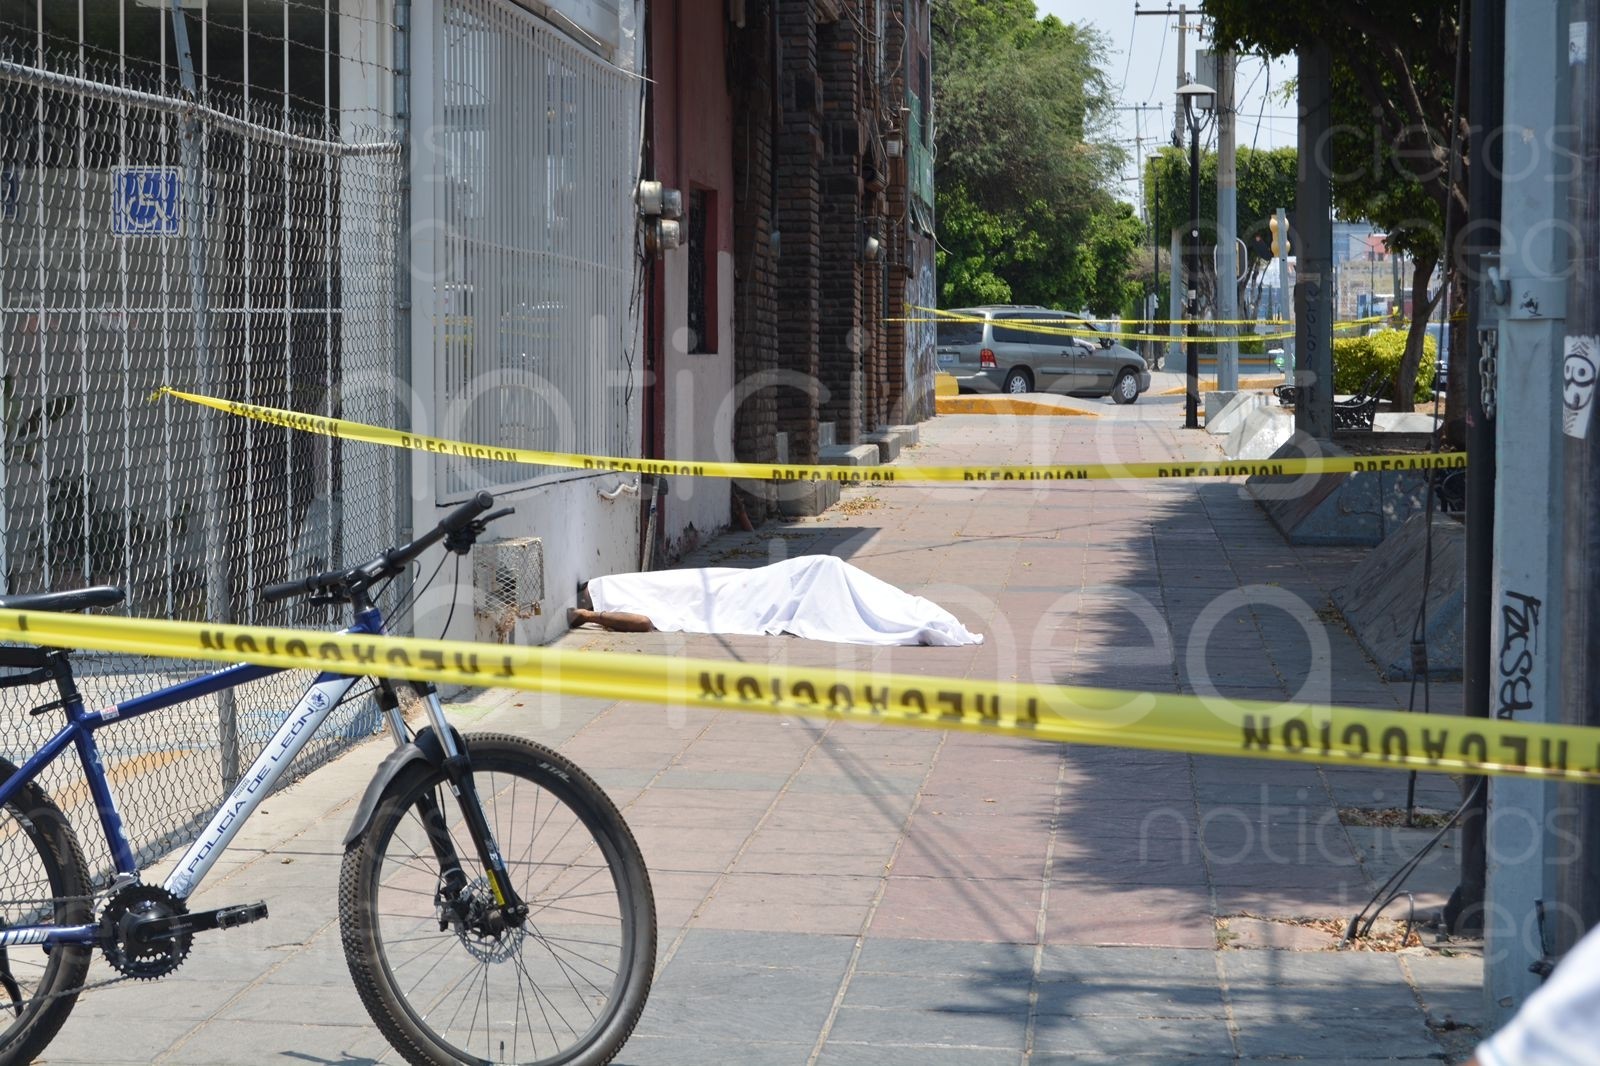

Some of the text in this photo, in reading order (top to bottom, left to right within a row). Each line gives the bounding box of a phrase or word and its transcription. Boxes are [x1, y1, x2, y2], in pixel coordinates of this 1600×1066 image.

[1353, 455, 1466, 472] PRECAUCIO
[187, 800, 246, 873] POLICÍA
[247, 766, 272, 794] DE
[271, 707, 316, 762] LEÓN
